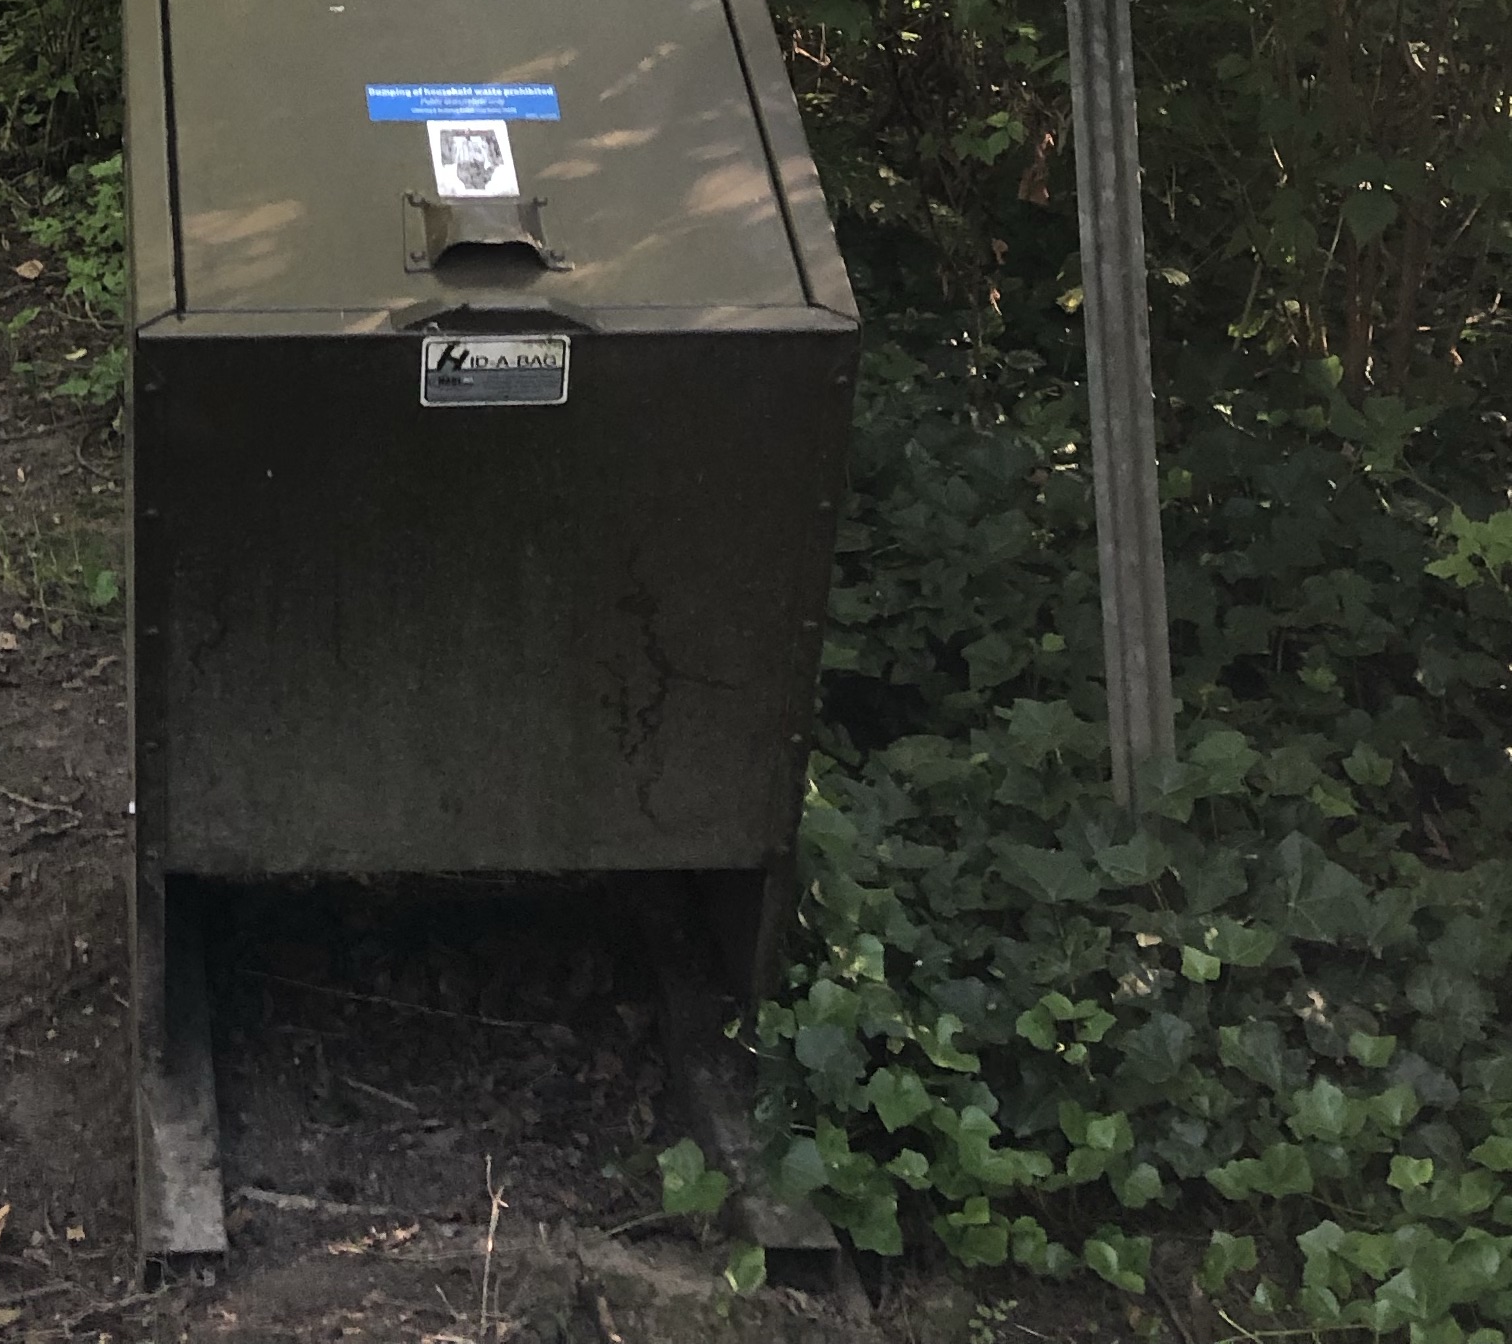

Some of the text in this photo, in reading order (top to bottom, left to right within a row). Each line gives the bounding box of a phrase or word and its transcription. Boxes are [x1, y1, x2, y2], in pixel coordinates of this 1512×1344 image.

[368, 87, 411, 97] Dumping
[413, 87, 423, 95] of
[424, 87, 472, 95] household
[504, 87, 554, 97] prohibited
